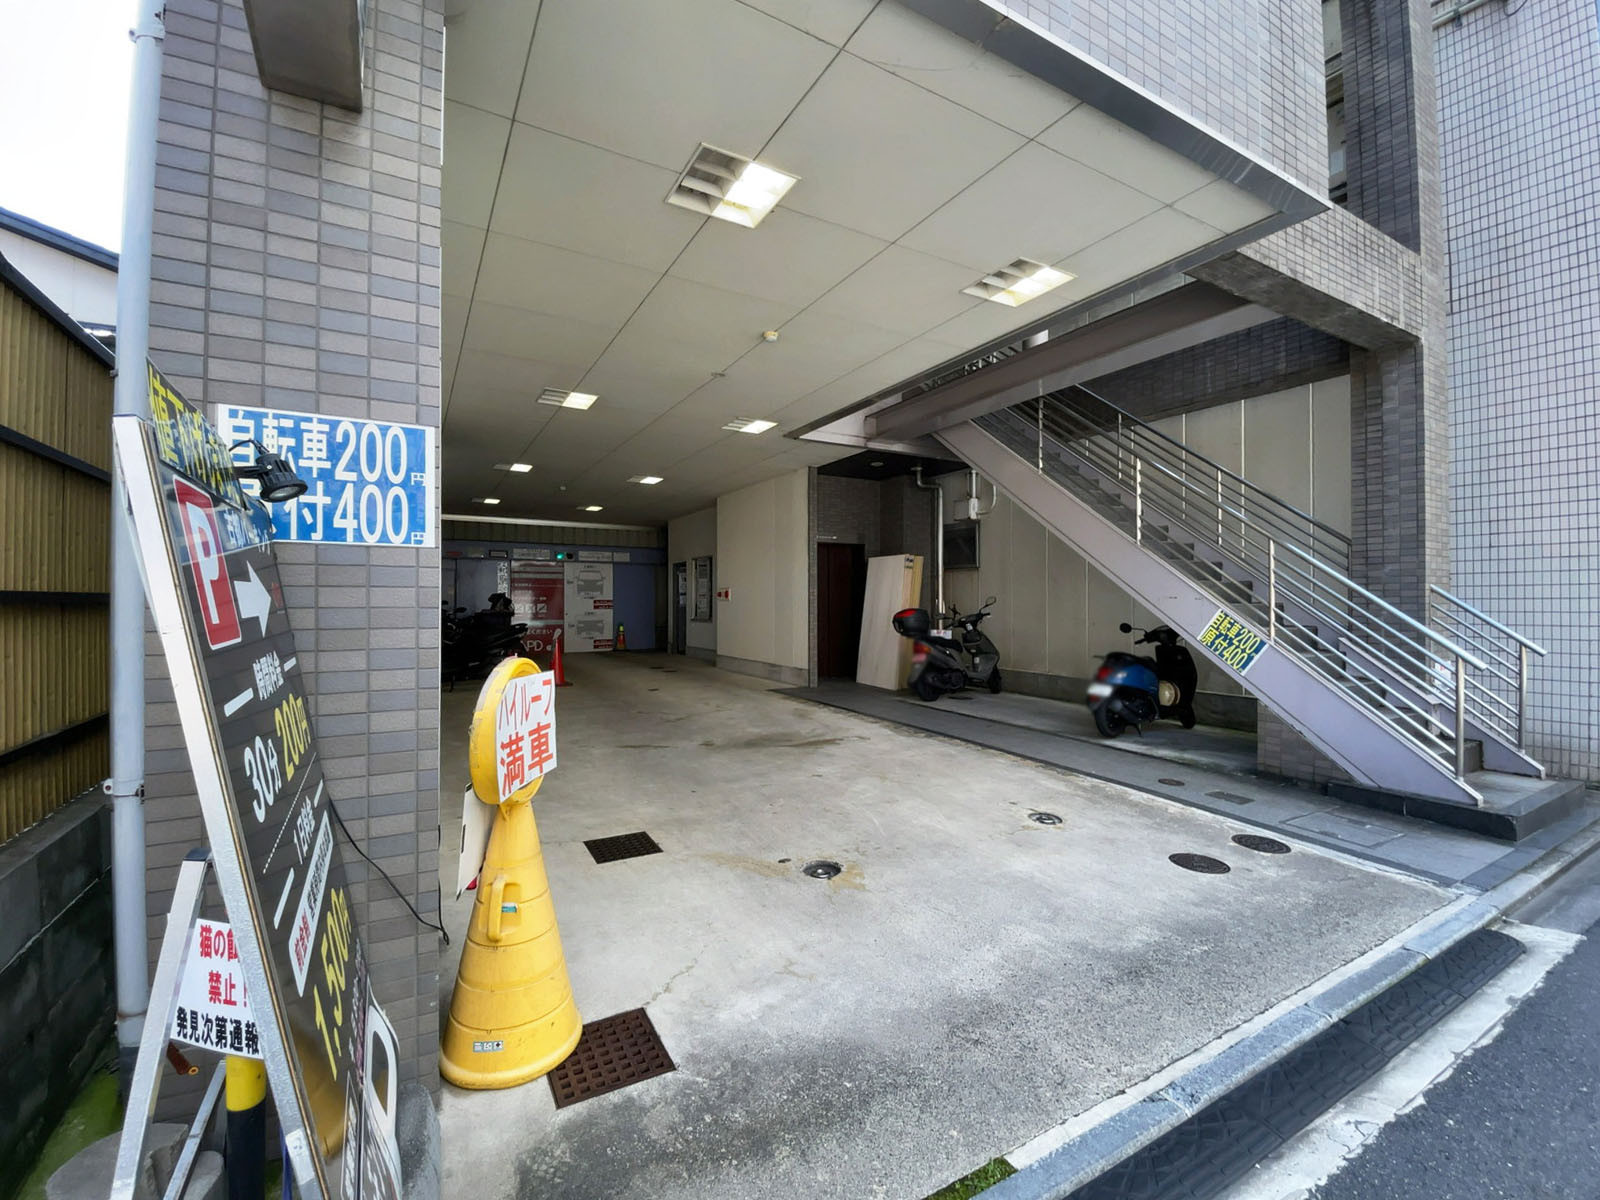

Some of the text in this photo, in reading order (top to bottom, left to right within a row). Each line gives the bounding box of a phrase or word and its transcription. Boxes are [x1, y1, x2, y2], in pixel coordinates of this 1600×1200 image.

[238, 478, 426, 546] 付400円
[498, 679, 553, 730] ハイルーフ
[244, 693, 311, 823] 30分 200円
[500, 722, 554, 797] 満車
